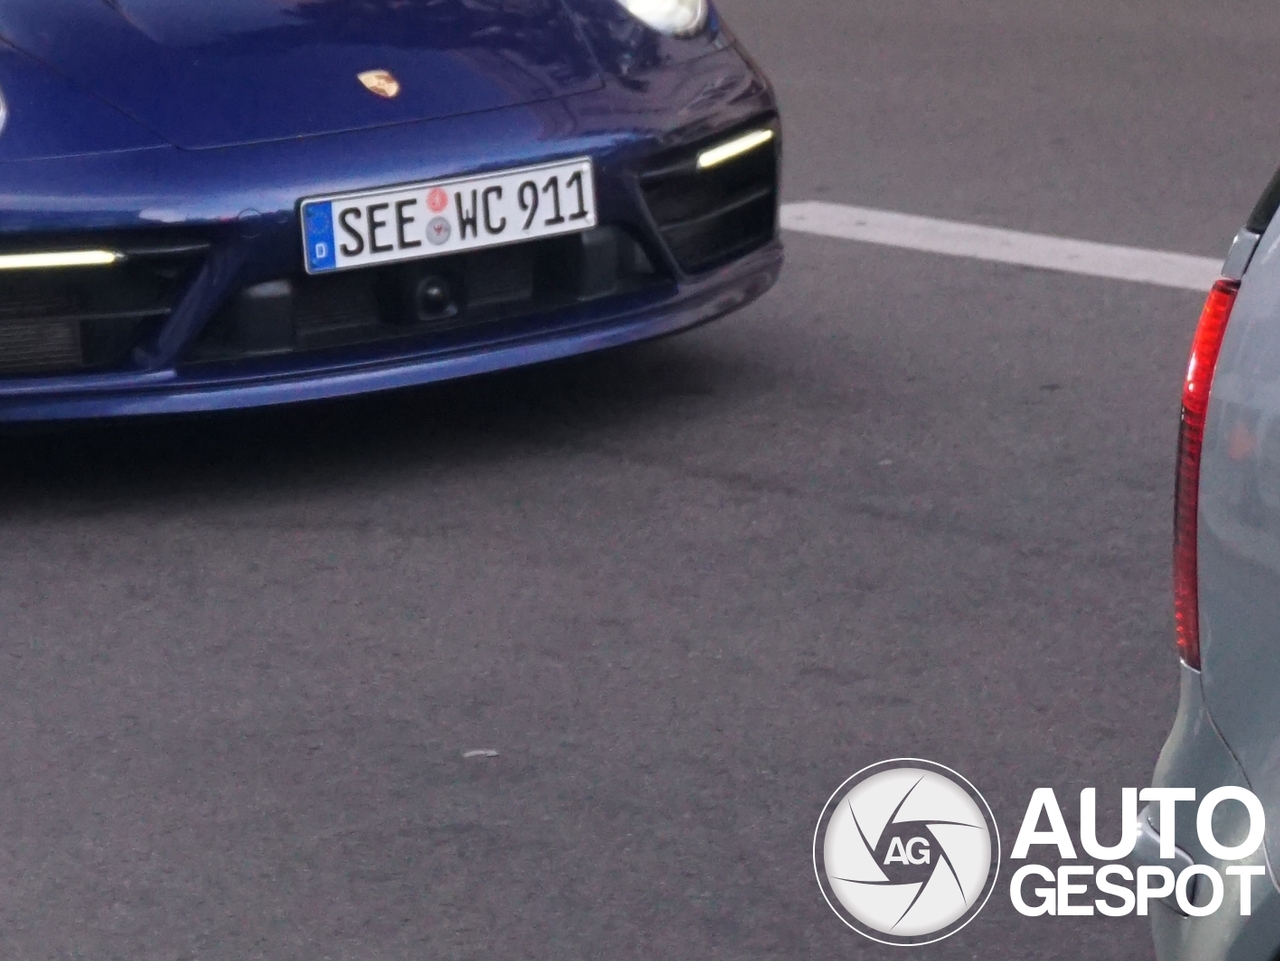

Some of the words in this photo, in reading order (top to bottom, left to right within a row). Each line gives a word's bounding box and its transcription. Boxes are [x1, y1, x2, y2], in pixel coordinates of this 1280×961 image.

[338, 198, 422, 258] SEE
[453, 185, 507, 241] WC
[517, 170, 590, 231] 911
